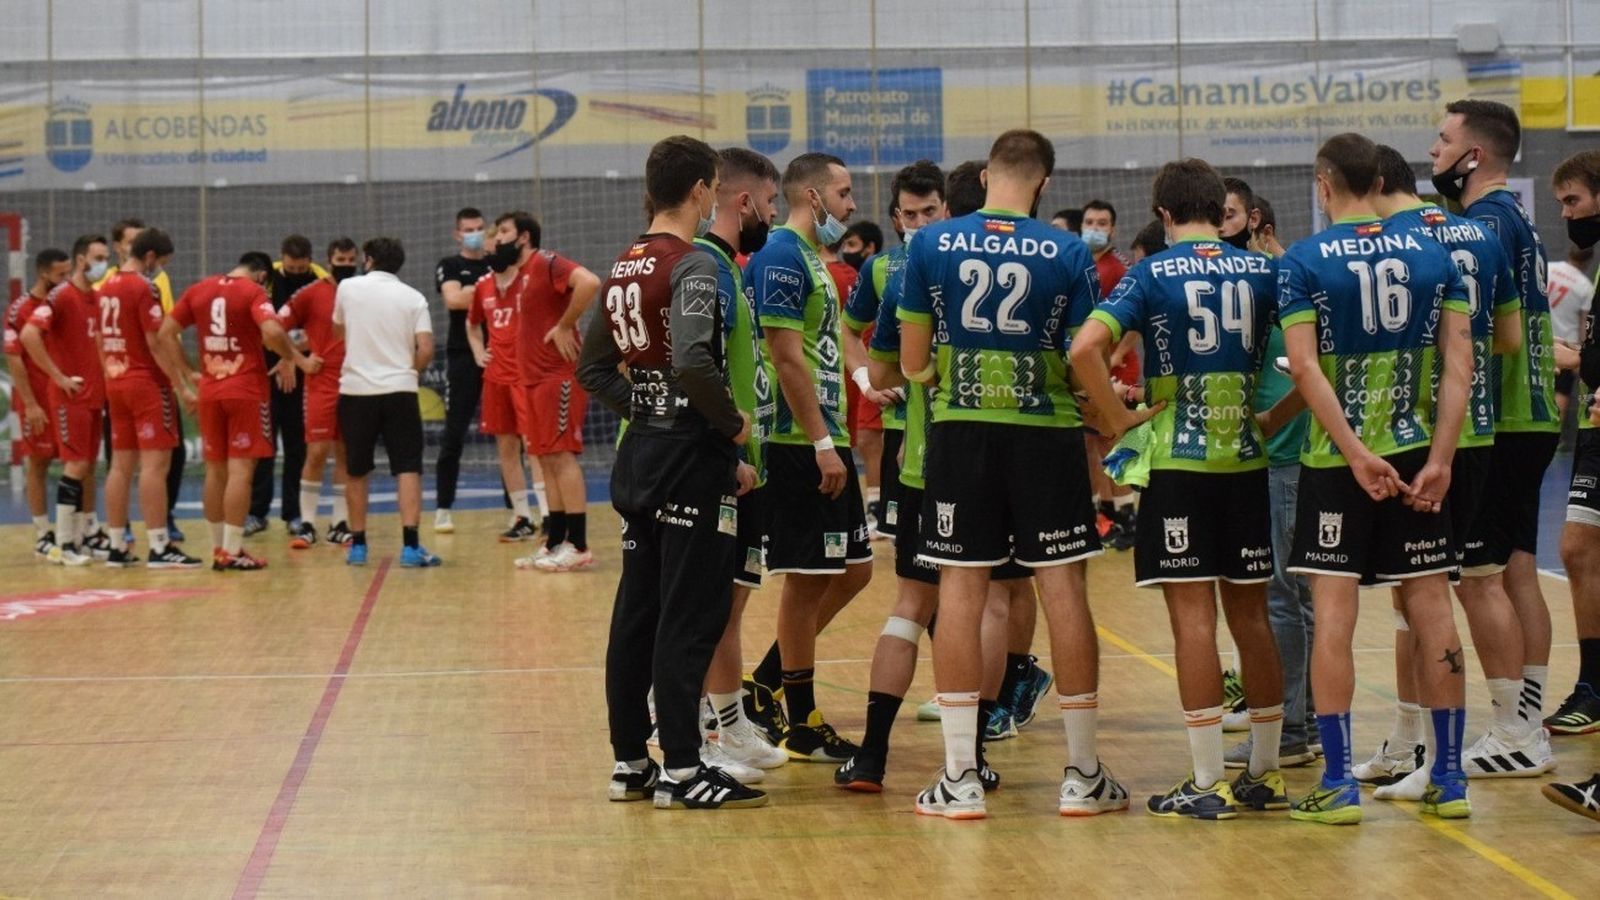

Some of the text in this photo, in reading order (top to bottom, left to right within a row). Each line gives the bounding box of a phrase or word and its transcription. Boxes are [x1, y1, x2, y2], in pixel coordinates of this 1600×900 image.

[825, 87, 909, 103] Patronato
[1106, 72, 1442, 108] #GananLosValores
[426, 83, 527, 131] abono
[825, 107, 930, 127] Municipal de
[104, 114, 267, 140] ALCOBENDAS
[825, 131, 905, 149] Deportes
[187, 148, 207, 164] de
[210, 147, 268, 163] ciudad
[938, 232, 1059, 259] SALGADO
[1319, 234, 1423, 258] MEDINA
[767, 271, 801, 286] iKasa
[958, 258, 1032, 336] 22
[1346, 257, 1413, 336] 16
[100, 296, 122, 336] 22
[210, 297, 228, 336] 9
[493, 307, 513, 328] 27
[606, 281, 650, 355] 33
[928, 283, 950, 344] iKasa
[1039, 294, 1068, 350] iKasa
[1183, 278, 1256, 355] 54
[1311, 289, 1335, 354] iKasa
[1420, 283, 1446, 345] iKasa
[1149, 313, 1175, 376] iKasa
[1038, 523, 1088, 543] Perlas en
[926, 539, 964, 554] MADRID
[1046, 539, 1087, 556] el barro
[1305, 551, 1349, 564] MADRID
[1404, 540, 1436, 553] Perlas
[1159, 556, 1200, 569] MADRID
[1246, 560, 1258, 571] el
[1410, 554, 1422, 565] el
